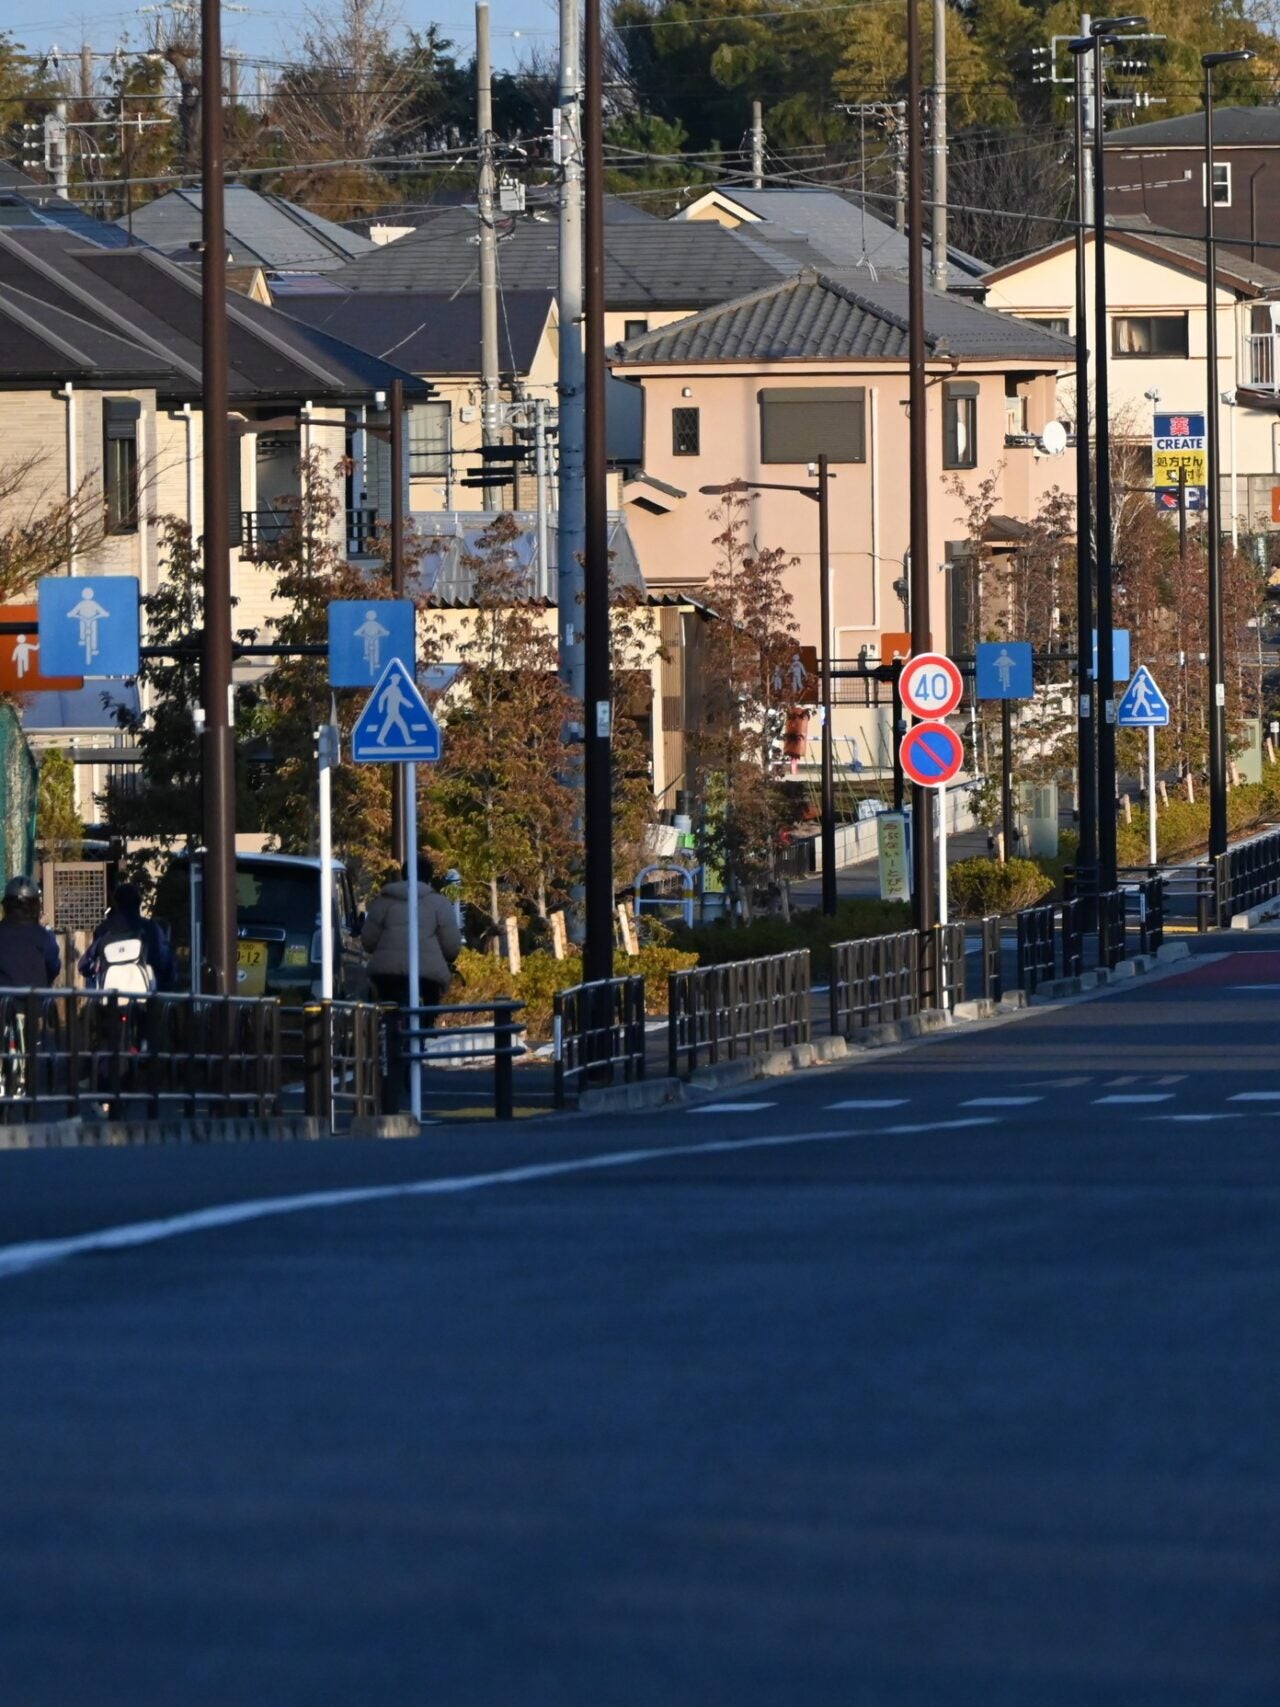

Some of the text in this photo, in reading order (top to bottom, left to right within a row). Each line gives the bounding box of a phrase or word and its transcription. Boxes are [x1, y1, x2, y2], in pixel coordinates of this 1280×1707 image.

[1170, 416, 1190, 436] 薬
[1156, 438, 1203, 450] CREATE
[1156, 456, 1203, 468] 処方せん
[1184, 487, 1200, 508] P
[915, 672, 948, 701] 40
